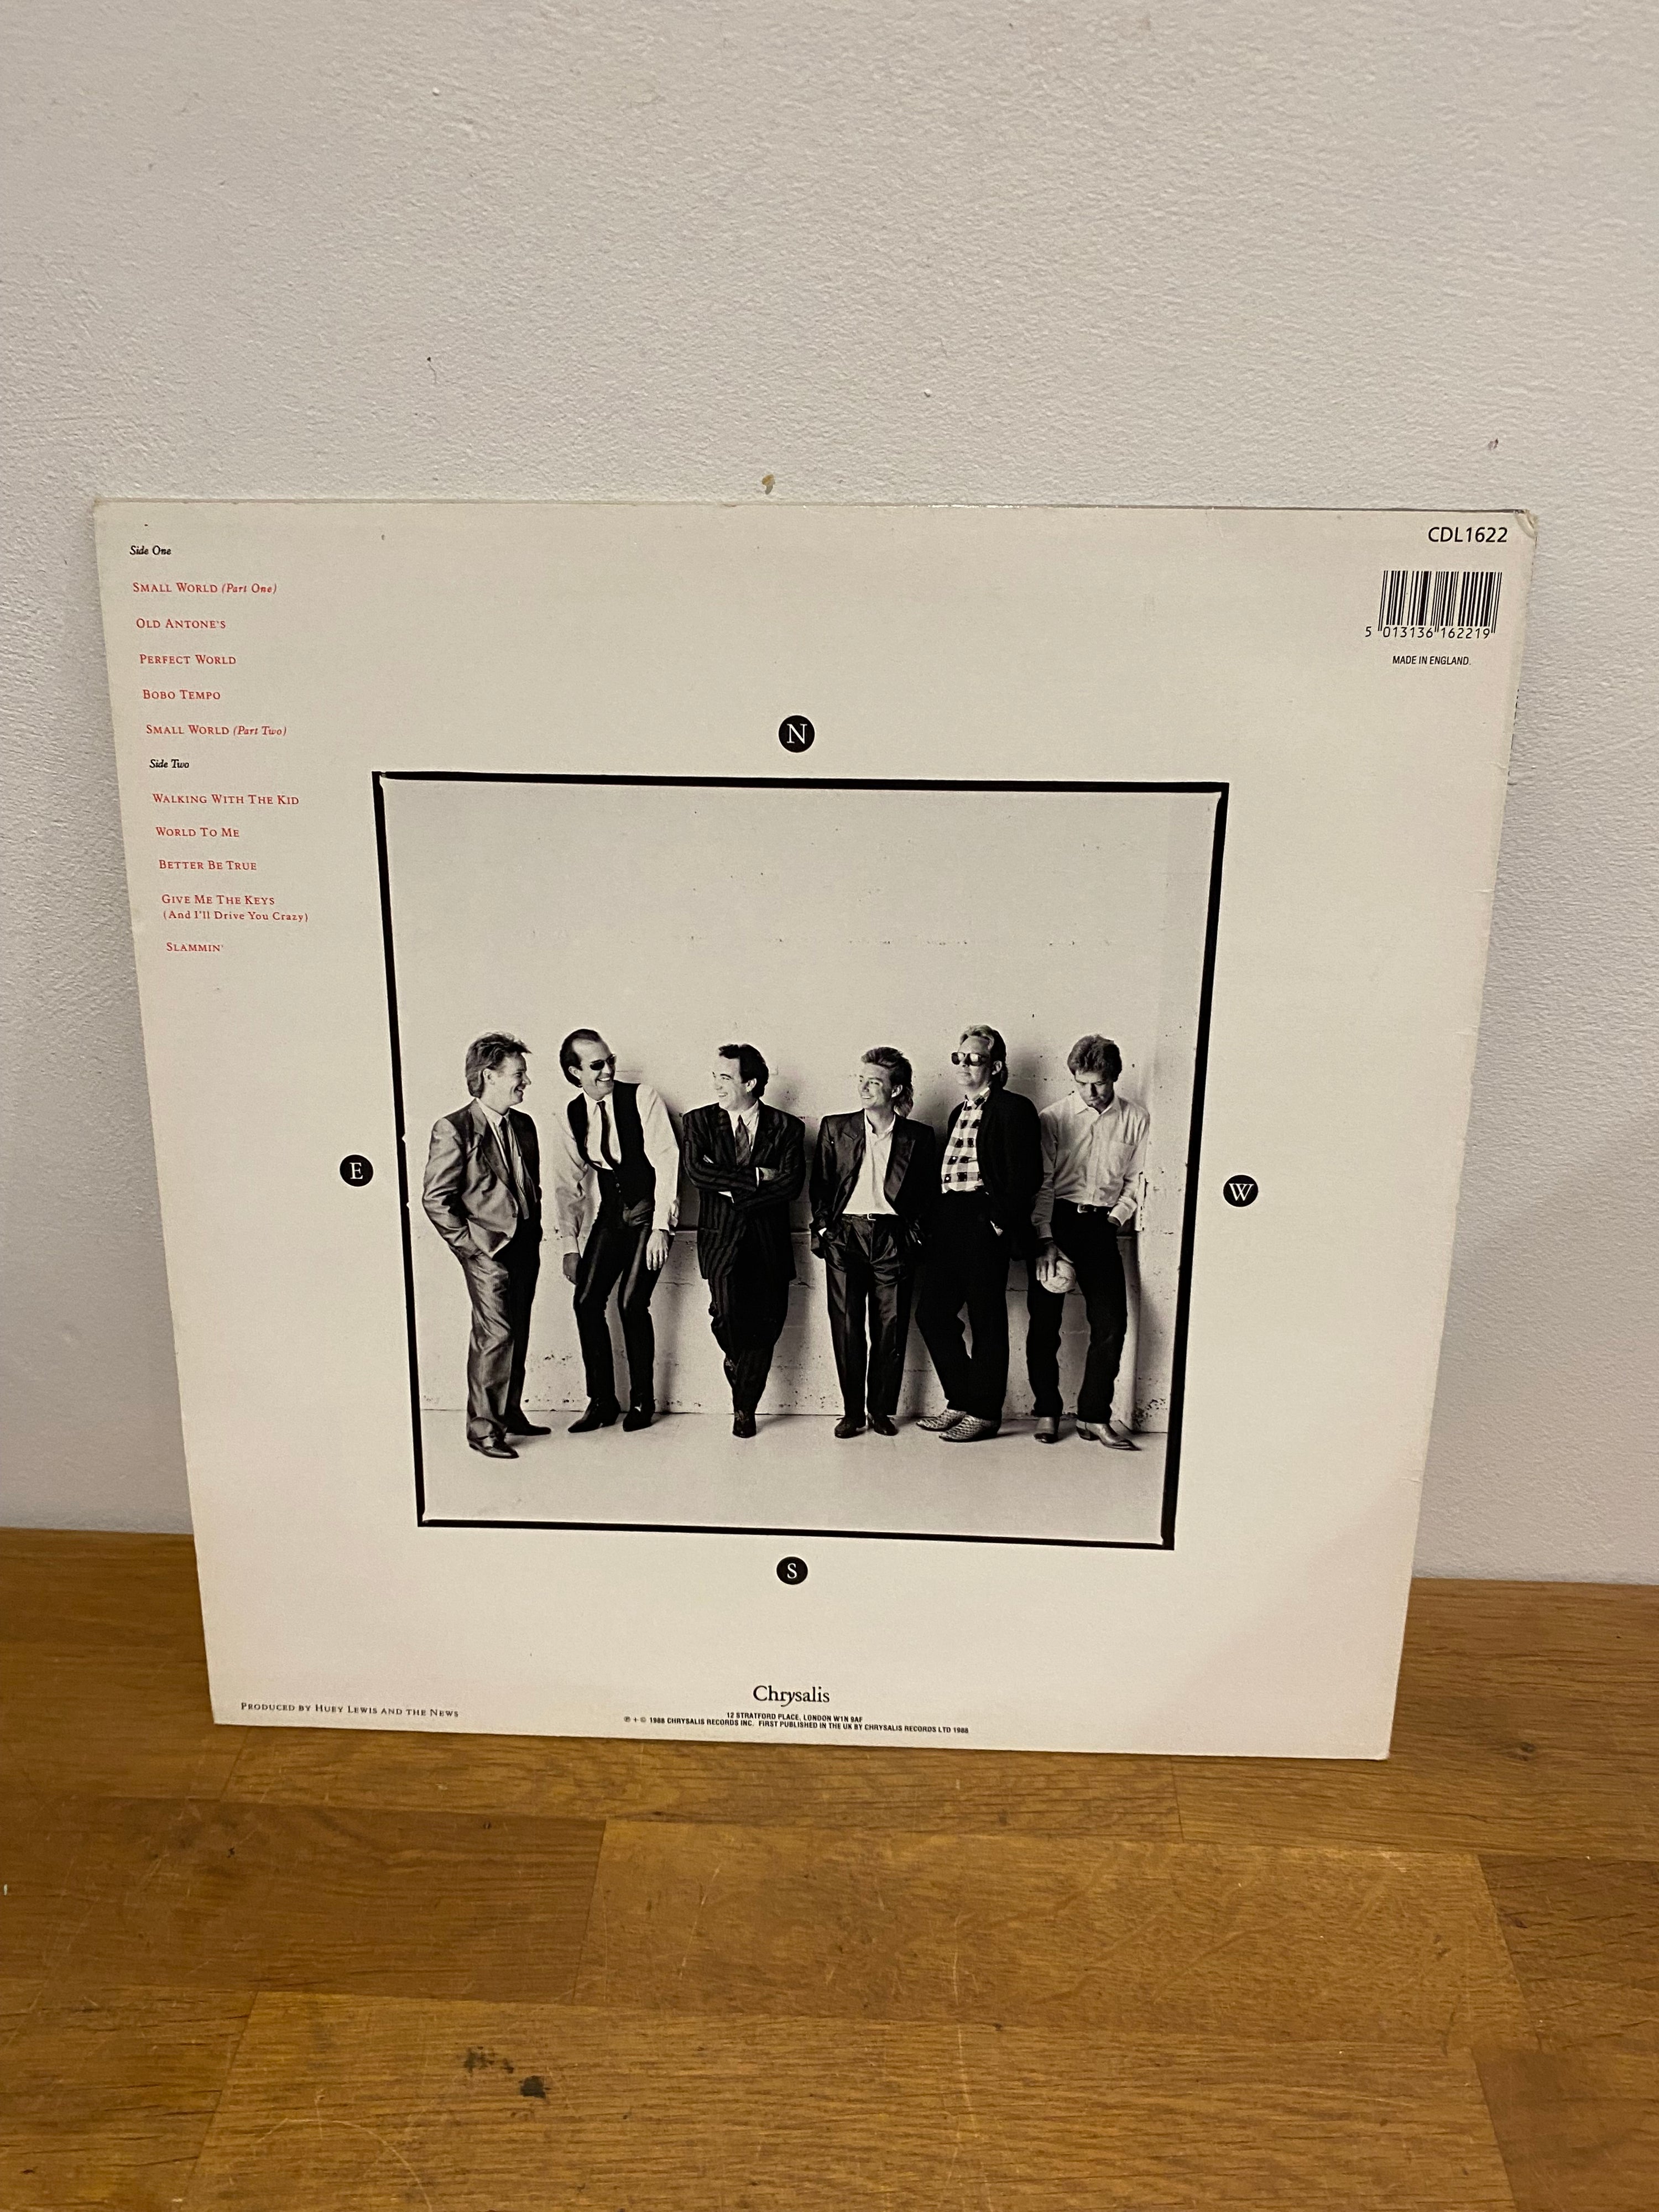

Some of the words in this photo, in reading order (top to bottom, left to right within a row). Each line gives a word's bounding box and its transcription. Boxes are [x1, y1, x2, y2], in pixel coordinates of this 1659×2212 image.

[1428, 527, 1508, 543] CDL1622
[129, 545, 149, 556] Side
[152, 545, 171, 556] One
[133, 582, 171, 593] SMALL
[176, 582, 217, 593] WORLD
[221, 583, 247, 594] (Part
[252, 583, 277, 594] One)
[135, 618, 160, 629] OLD
[165, 618, 226, 629] ANTONE'S
[1365, 627, 1371, 637] 5
[1383, 627, 1433, 638] 013136
[1441, 628, 1490, 639] 162219
[139, 654, 191, 665] PERFECT
[195, 654, 236, 665] WORLD
[1392, 656, 1416, 665] MADE
[1418, 656, 1427, 665] IN
[143, 689, 175, 700] BOBO
[180, 690, 221, 700] TEMPO
[146, 724, 184, 734] SMALL
[188, 724, 229, 735] WORLD
[233, 726, 258, 736] (Part
[262, 726, 287, 736] Two)
[786, 723, 807, 744] N
[149, 759, 168, 769] Side
[171, 759, 189, 769] Two
[152, 794, 207, 804] WALKING
[211, 794, 244, 804] WITH
[248, 795, 273, 805] THE
[277, 795, 299, 805] KID
[156, 826, 196, 837] WORLD
[200, 827, 217, 837] TO
[222, 828, 239, 838] ME
[159, 860, 204, 869] BETTER
[208, 860, 223, 870] BE
[226, 860, 257, 870] TRUE
[161, 894, 190, 904] GIVE
[194, 895, 212, 905] ME
[216, 895, 241, 905] THE
[244, 895, 275, 905] KEYS
[163, 911, 191, 920] (And
[194, 911, 210, 920] I'll
[214, 911, 244, 920] Drive
[248, 911, 269, 921] You
[272, 912, 309, 922] Crazy)
[349, 1161, 364, 1180] E
[1229, 1182, 1253, 1201] W
[786, 1562, 798, 1580] S
[753, 1685, 830, 1707] Chrysalis
[241, 1702, 295, 1712] PRODUCED
[315, 1704, 343, 1713] HUEY
[347, 1705, 378, 1714] LEWIS
[430, 1709, 459, 1717] NEWS
